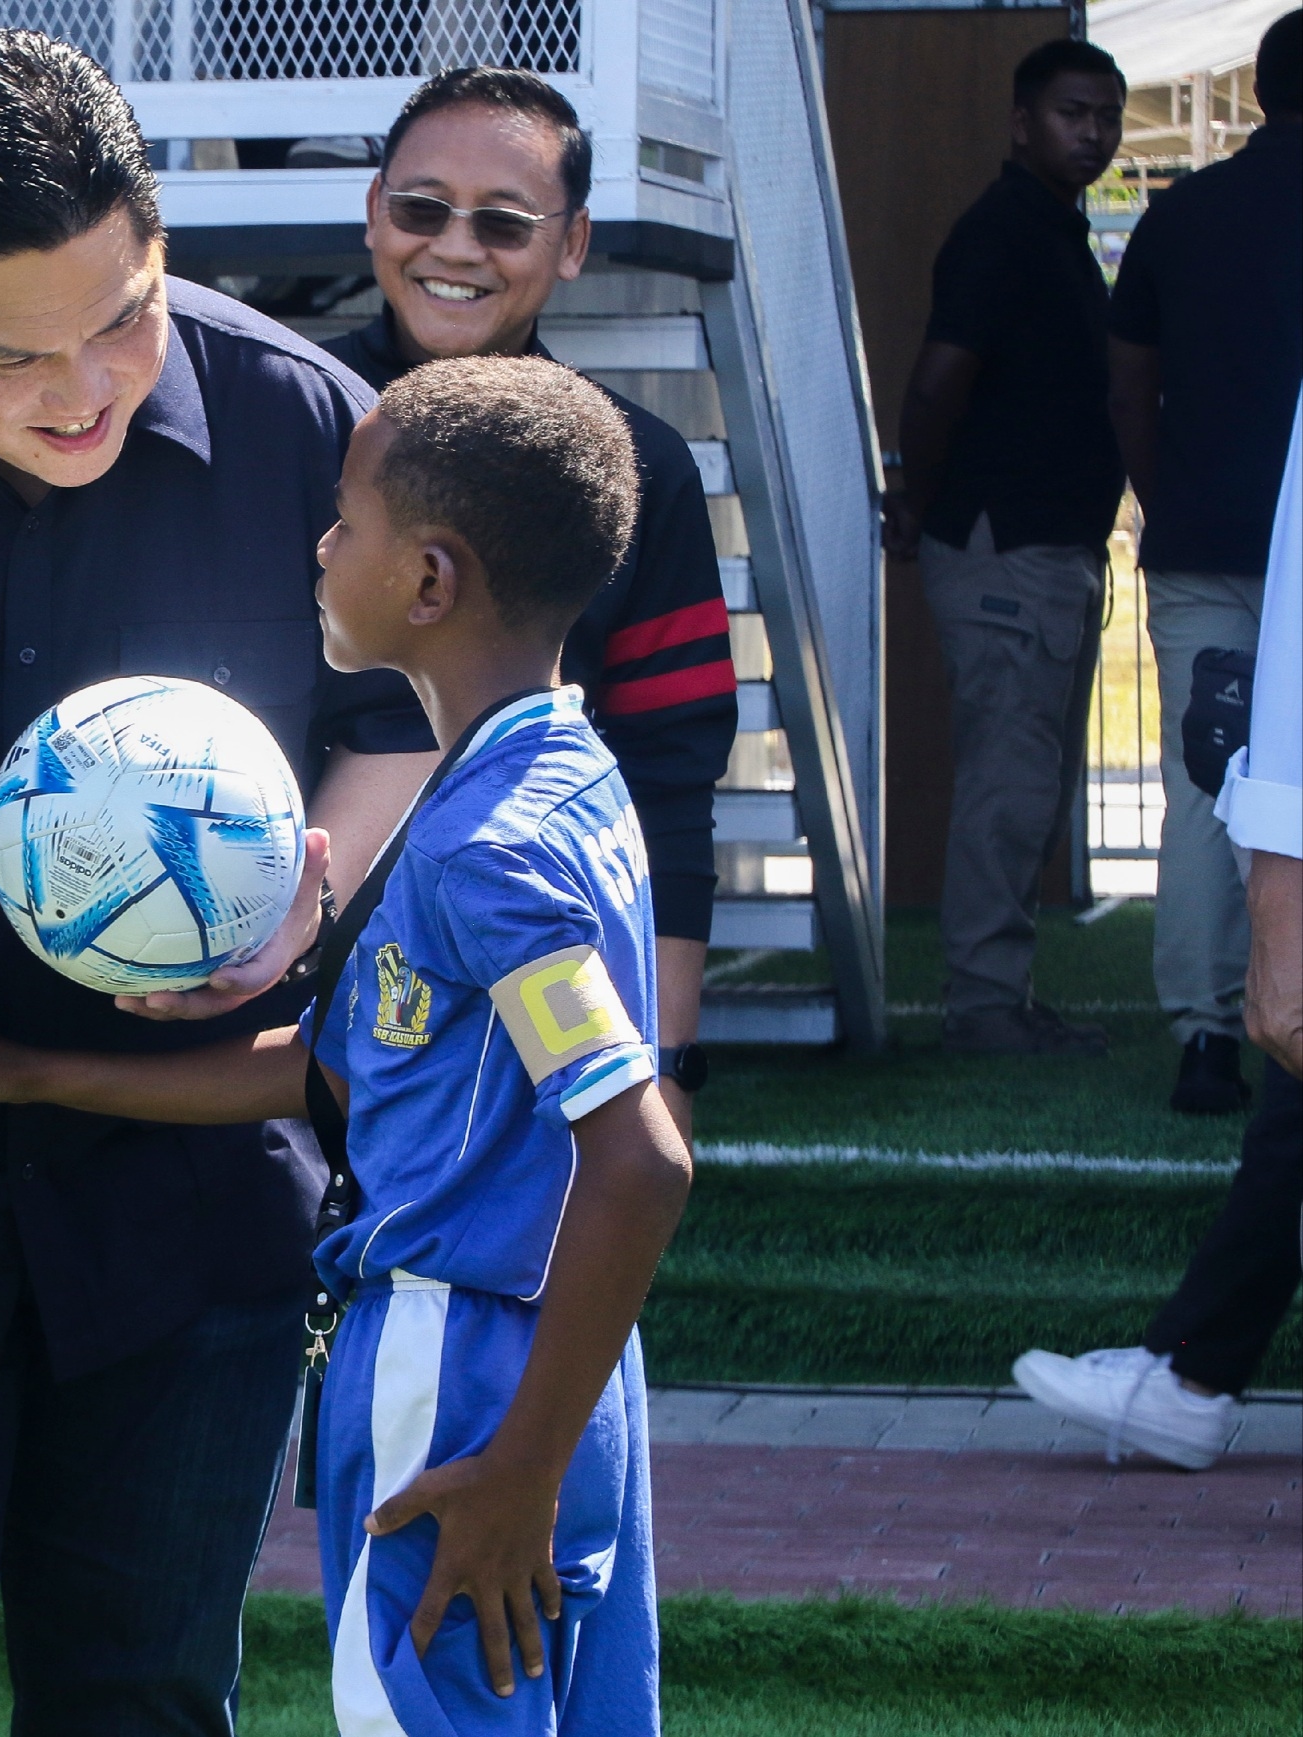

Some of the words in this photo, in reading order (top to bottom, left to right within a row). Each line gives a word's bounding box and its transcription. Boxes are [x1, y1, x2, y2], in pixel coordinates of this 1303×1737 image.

[139, 733, 171, 757] FIFA
[59, 855, 92, 877] adidas
[519, 959, 614, 1056] C
